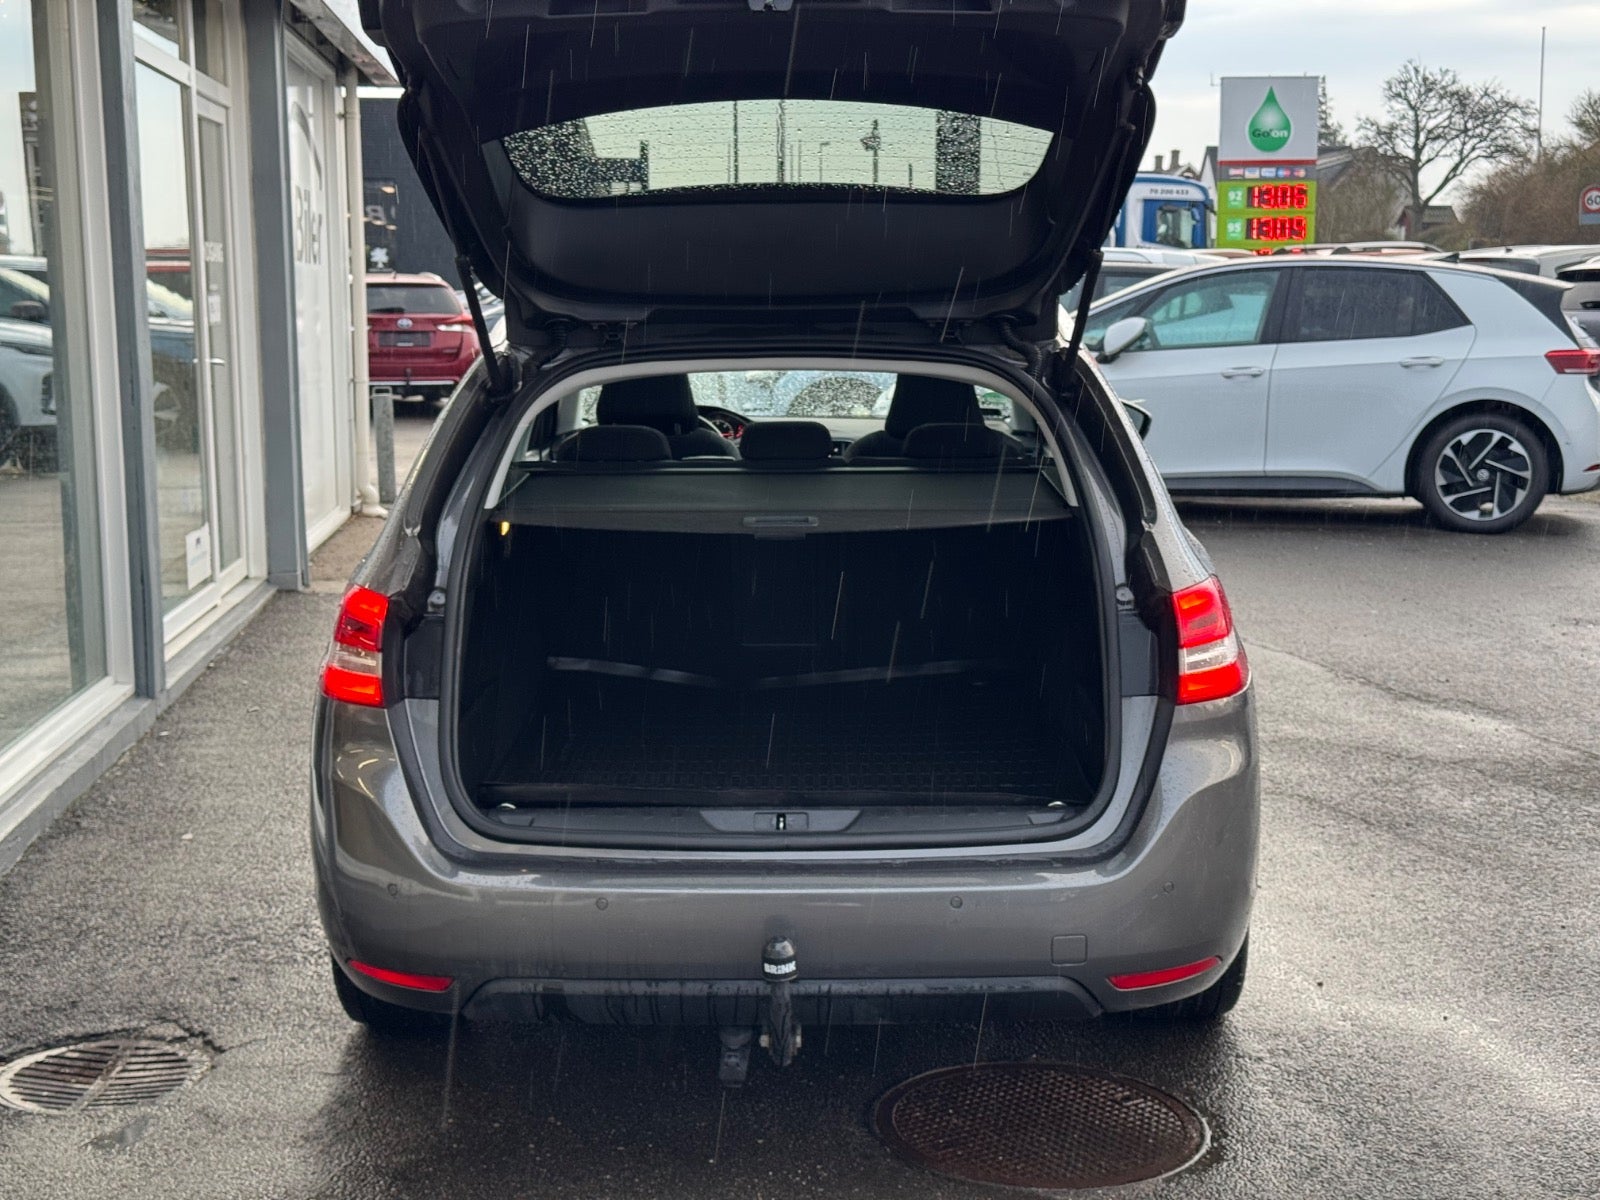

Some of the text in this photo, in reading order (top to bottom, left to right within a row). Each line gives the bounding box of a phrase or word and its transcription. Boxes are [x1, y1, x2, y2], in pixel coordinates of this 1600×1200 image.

[1228, 190, 1242, 201] 92
[1587, 195, 1600, 206] 60
[1227, 222, 1241, 233] 95
